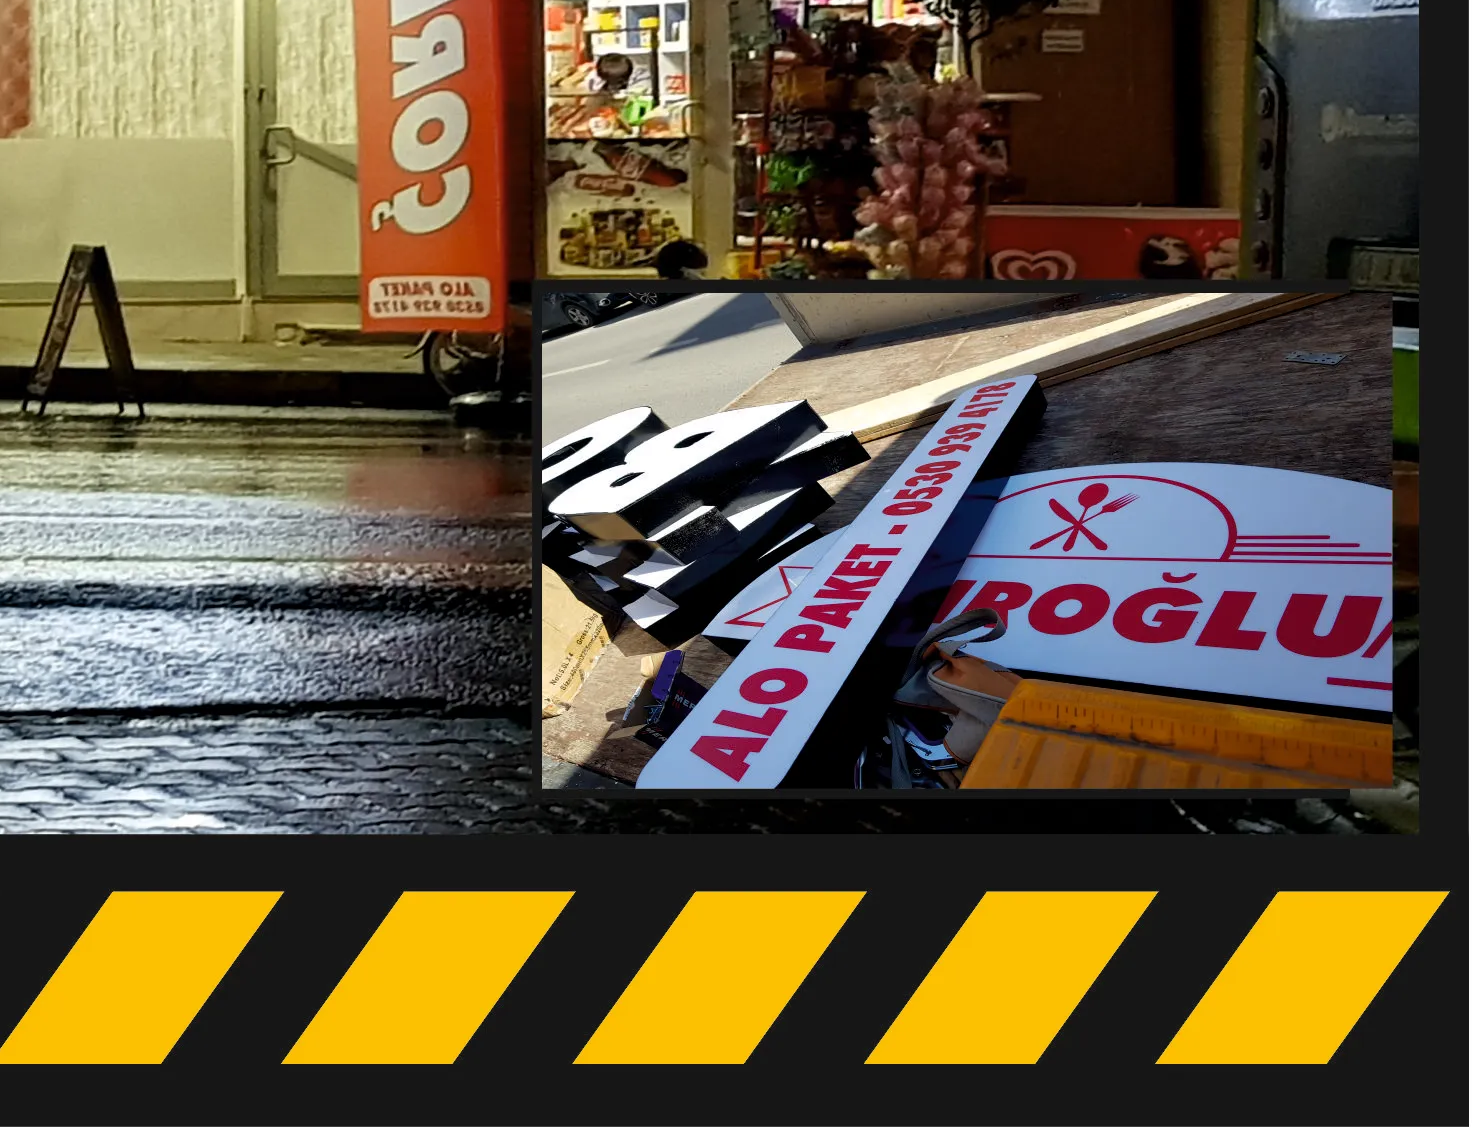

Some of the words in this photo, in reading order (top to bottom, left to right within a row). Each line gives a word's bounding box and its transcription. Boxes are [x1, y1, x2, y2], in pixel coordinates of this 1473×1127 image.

[957, 381, 1017, 418] 4178
[928, 423, 987, 457] 939
[882, 460, 961, 517] 0530
[774, 542, 903, 654] PAKET
[933, 572, 1383, 659] IROĞLU
[690, 667, 808, 783] ALO
